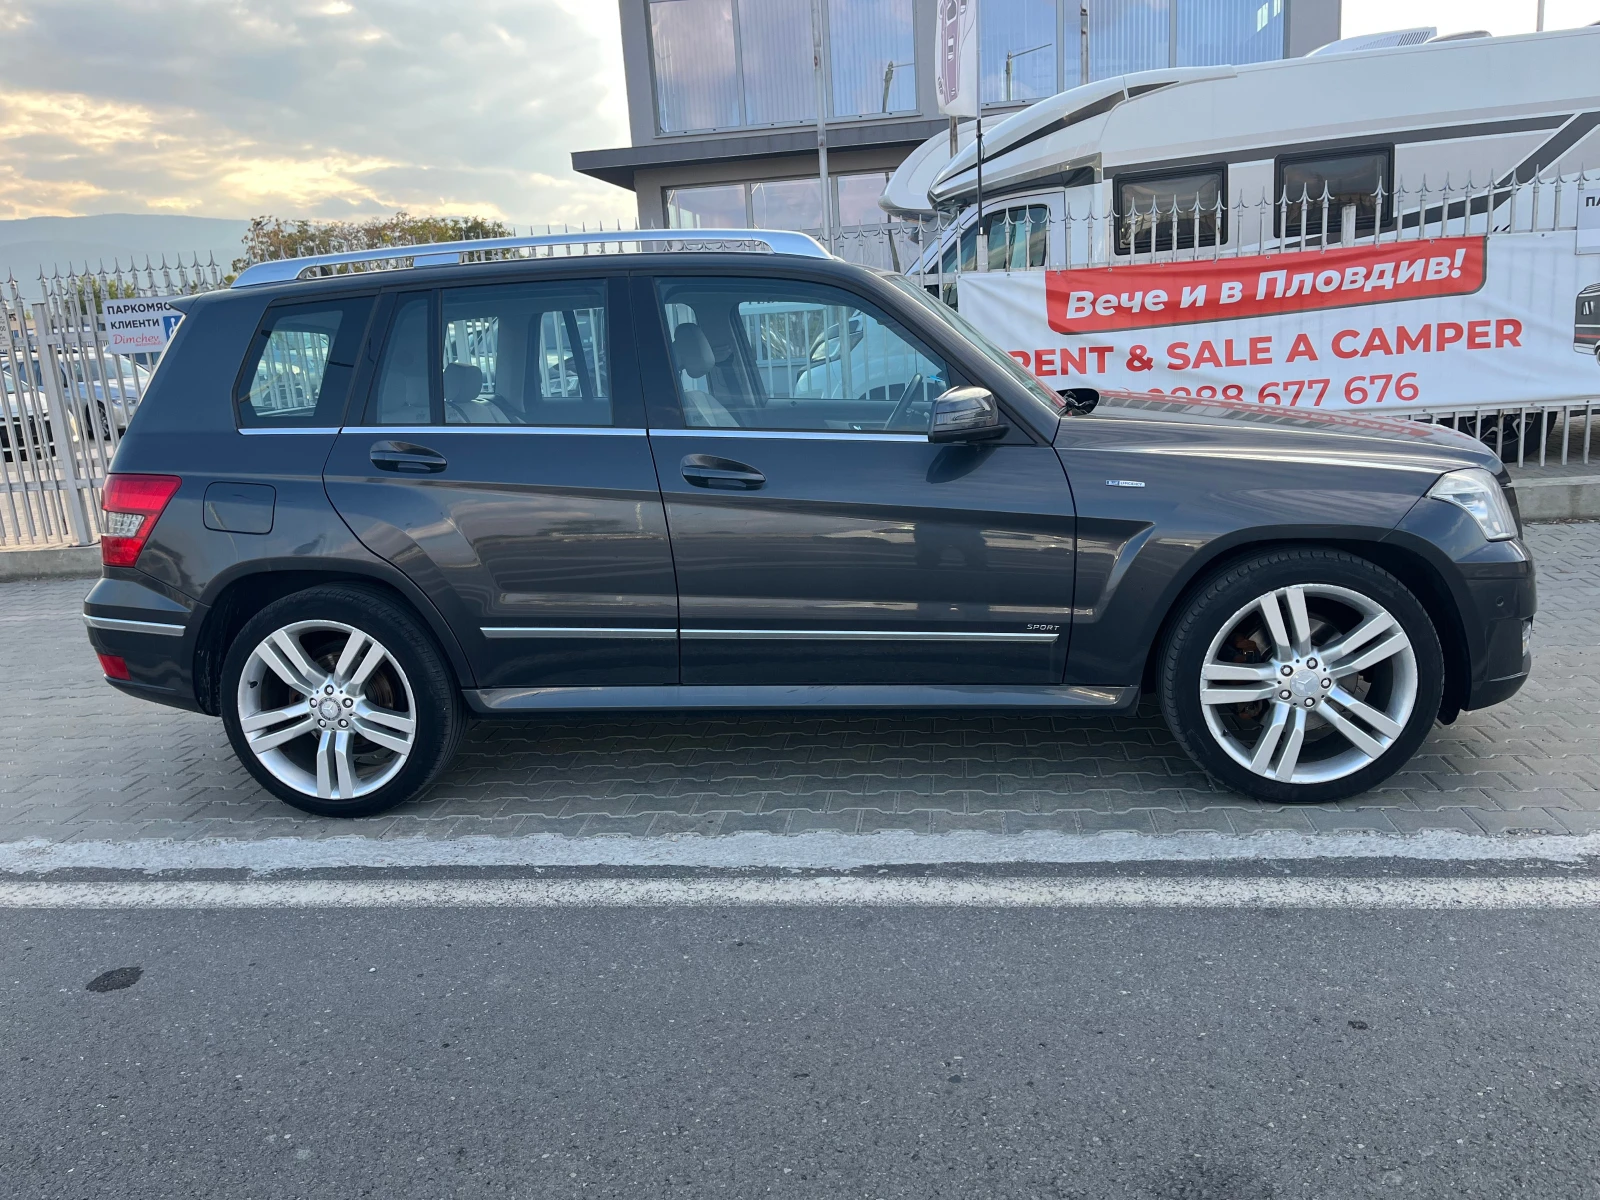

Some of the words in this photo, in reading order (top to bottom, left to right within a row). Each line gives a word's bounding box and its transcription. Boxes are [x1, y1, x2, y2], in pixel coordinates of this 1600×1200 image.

[1066, 289, 1168, 319] Вече
[1180, 284, 1207, 309] и
[1219, 281, 1243, 305] в
[1256, 248, 1466, 300] Пловдив!
[110, 318, 160, 330] КЛИЕНТИ
[113, 333, 159, 345] Dimchev
[1126, 344, 1154, 372] &
[1167, 336, 1273, 371] SALE
[1285, 333, 1319, 363] A
[1331, 318, 1523, 359] CAMPER
[1258, 378, 1331, 407] 677
[1344, 372, 1419, 405] 676
[1026, 623, 1060, 631] SPORT
